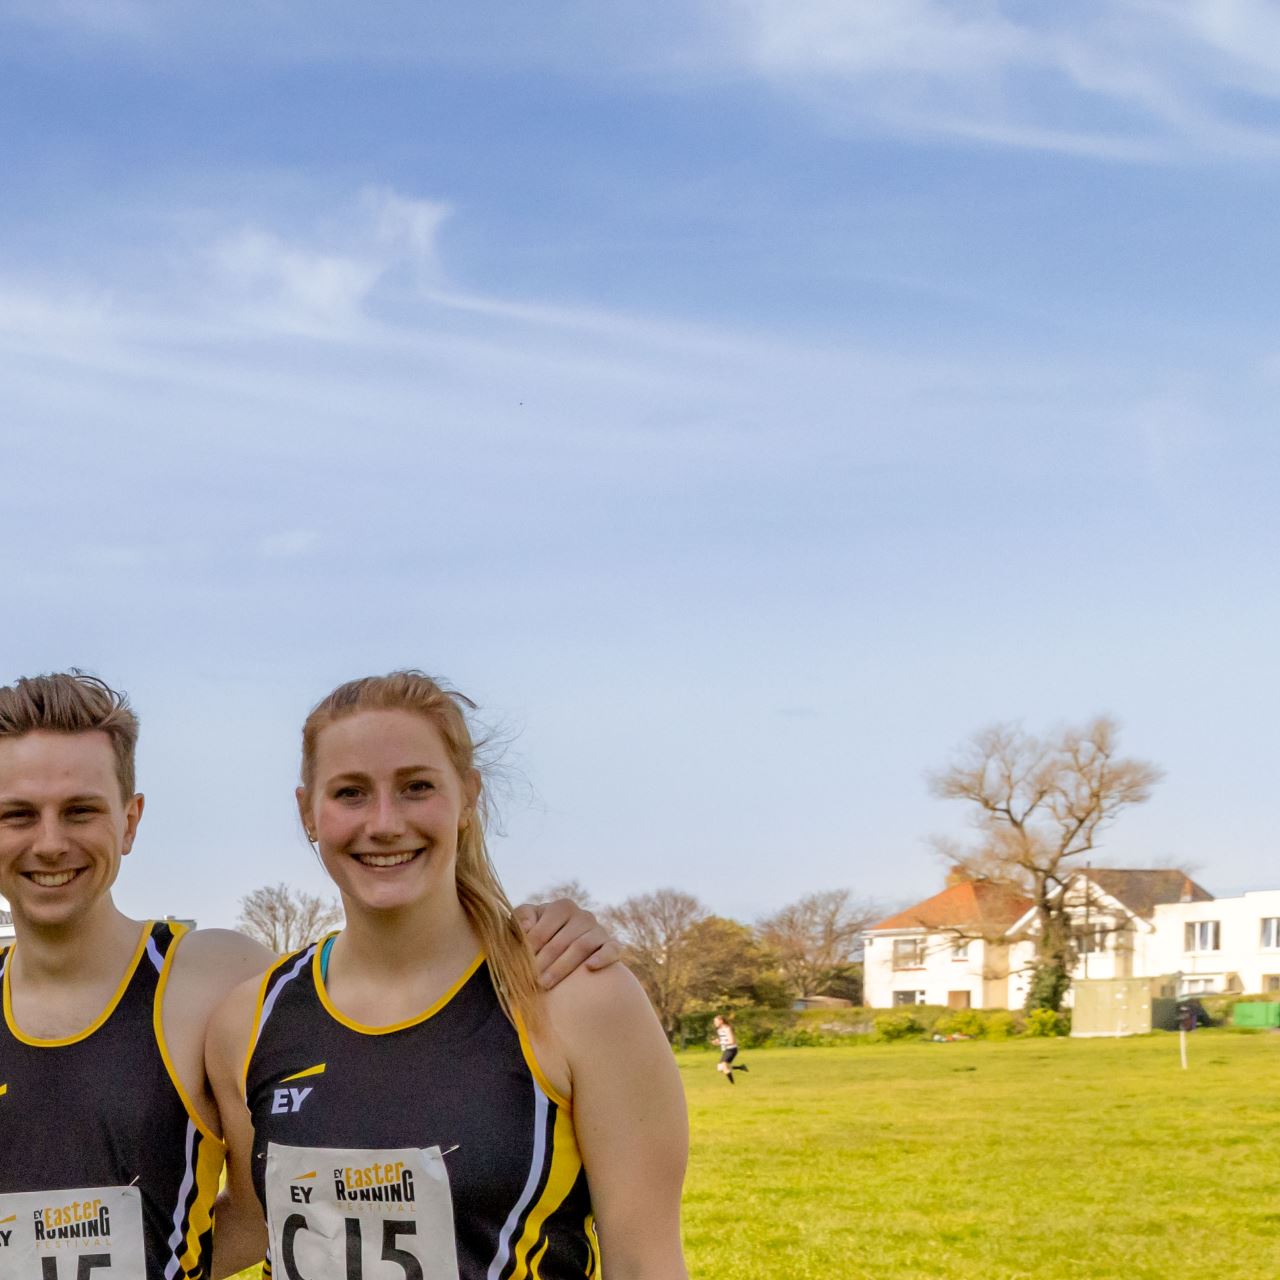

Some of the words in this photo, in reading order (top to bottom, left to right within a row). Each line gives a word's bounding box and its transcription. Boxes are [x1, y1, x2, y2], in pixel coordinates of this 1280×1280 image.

[271, 1087, 313, 1115] EY
[334, 1168, 344, 1179] EY
[345, 1160, 405, 1190] Easter
[335, 1169, 415, 1202] RUNNING
[290, 1185, 313, 1204] EY
[336, 1201, 416, 1212] FESTIVAL
[33, 1209, 44, 1220] EY
[44, 1199, 102, 1228] Easter
[35, 1205, 110, 1241] RUNNING
[36, 1239, 112, 1249] FESTIVAL
